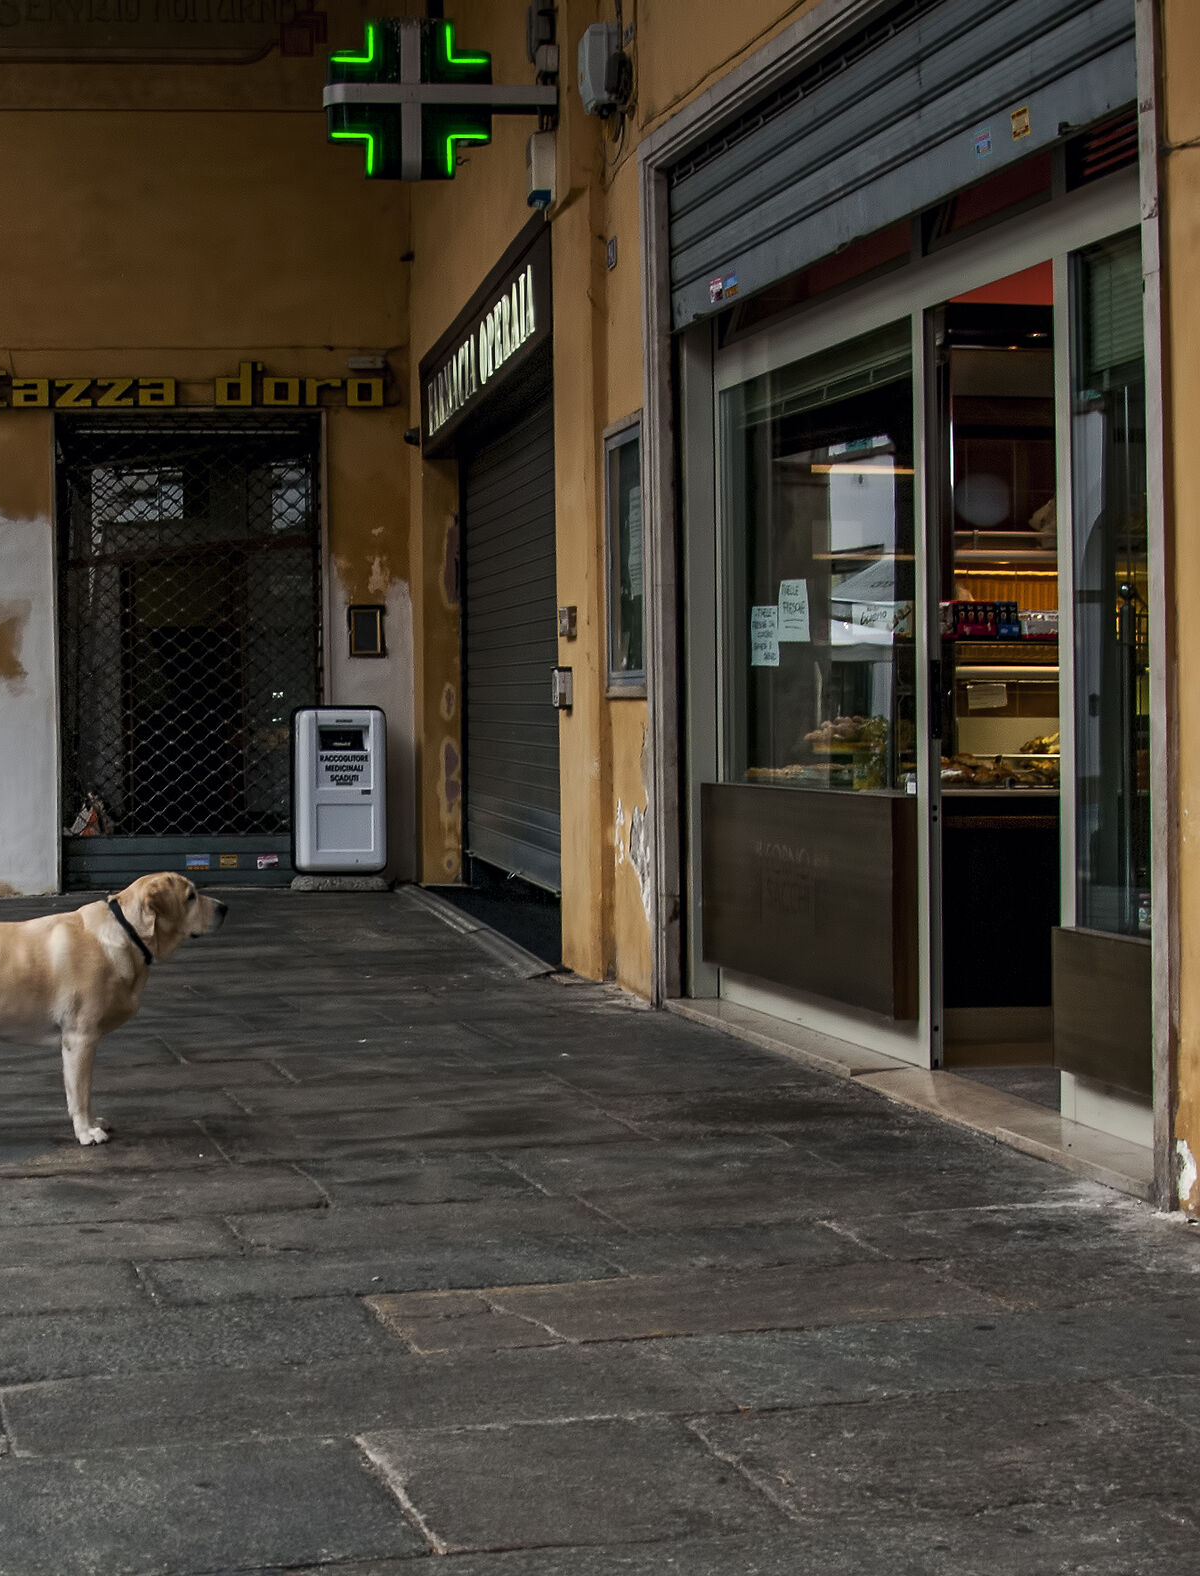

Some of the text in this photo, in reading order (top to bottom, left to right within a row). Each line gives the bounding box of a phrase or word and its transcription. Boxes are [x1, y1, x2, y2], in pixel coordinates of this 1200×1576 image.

[319, 754, 369, 763] RACCOGLITORE
[325, 764, 364, 772] MEDICINALI
[330, 774, 359, 782] SCADUTI
